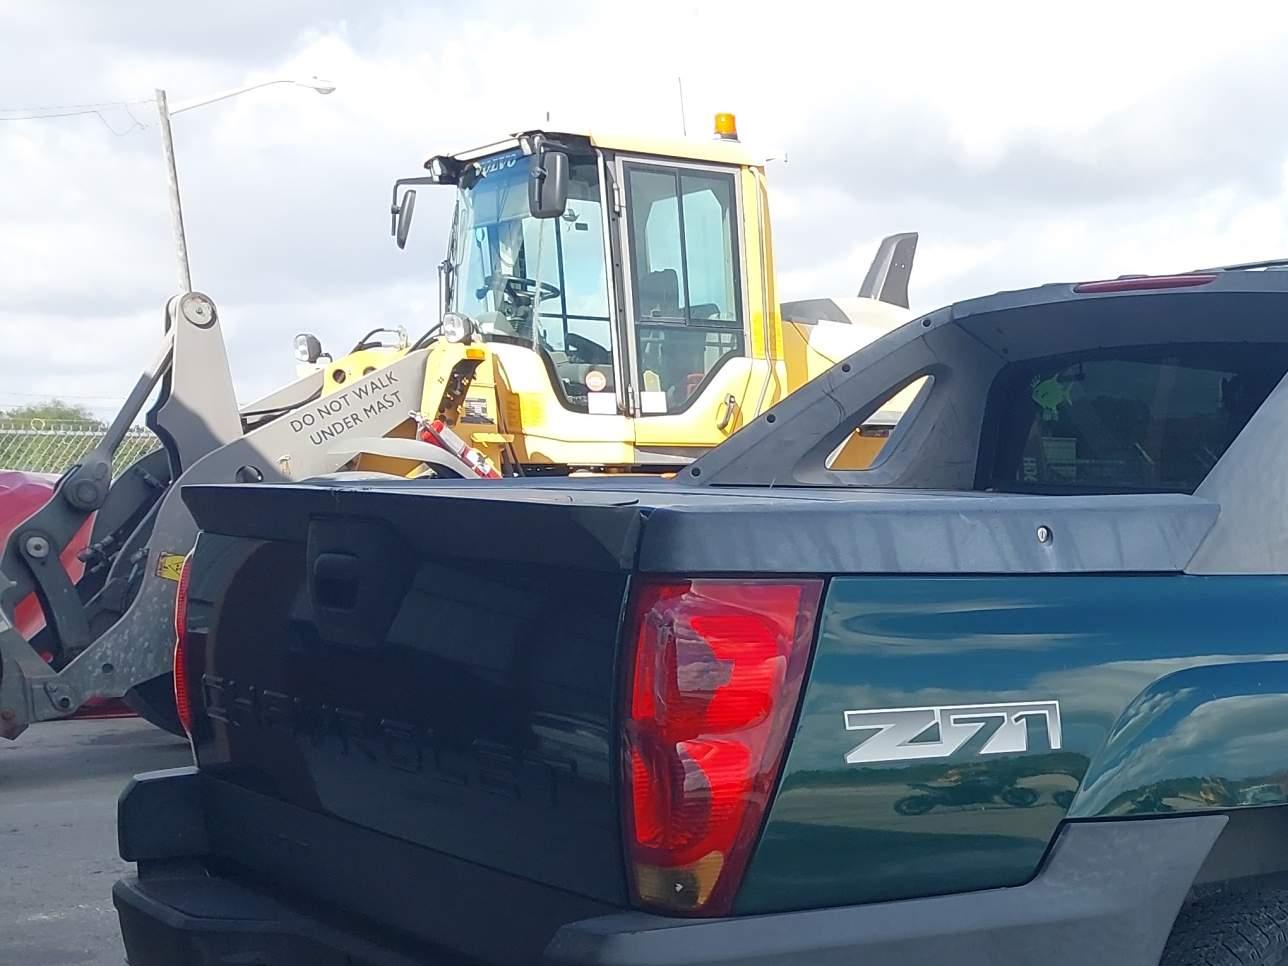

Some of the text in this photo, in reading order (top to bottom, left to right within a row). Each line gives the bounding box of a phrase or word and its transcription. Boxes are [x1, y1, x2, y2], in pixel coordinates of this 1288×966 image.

[290, 371, 399, 433] DO NOT WALK
[309, 390, 401, 445] UNDER MAST
[201, 672, 581, 808] CHEVROLET
[843, 700, 1062, 765] Z71
